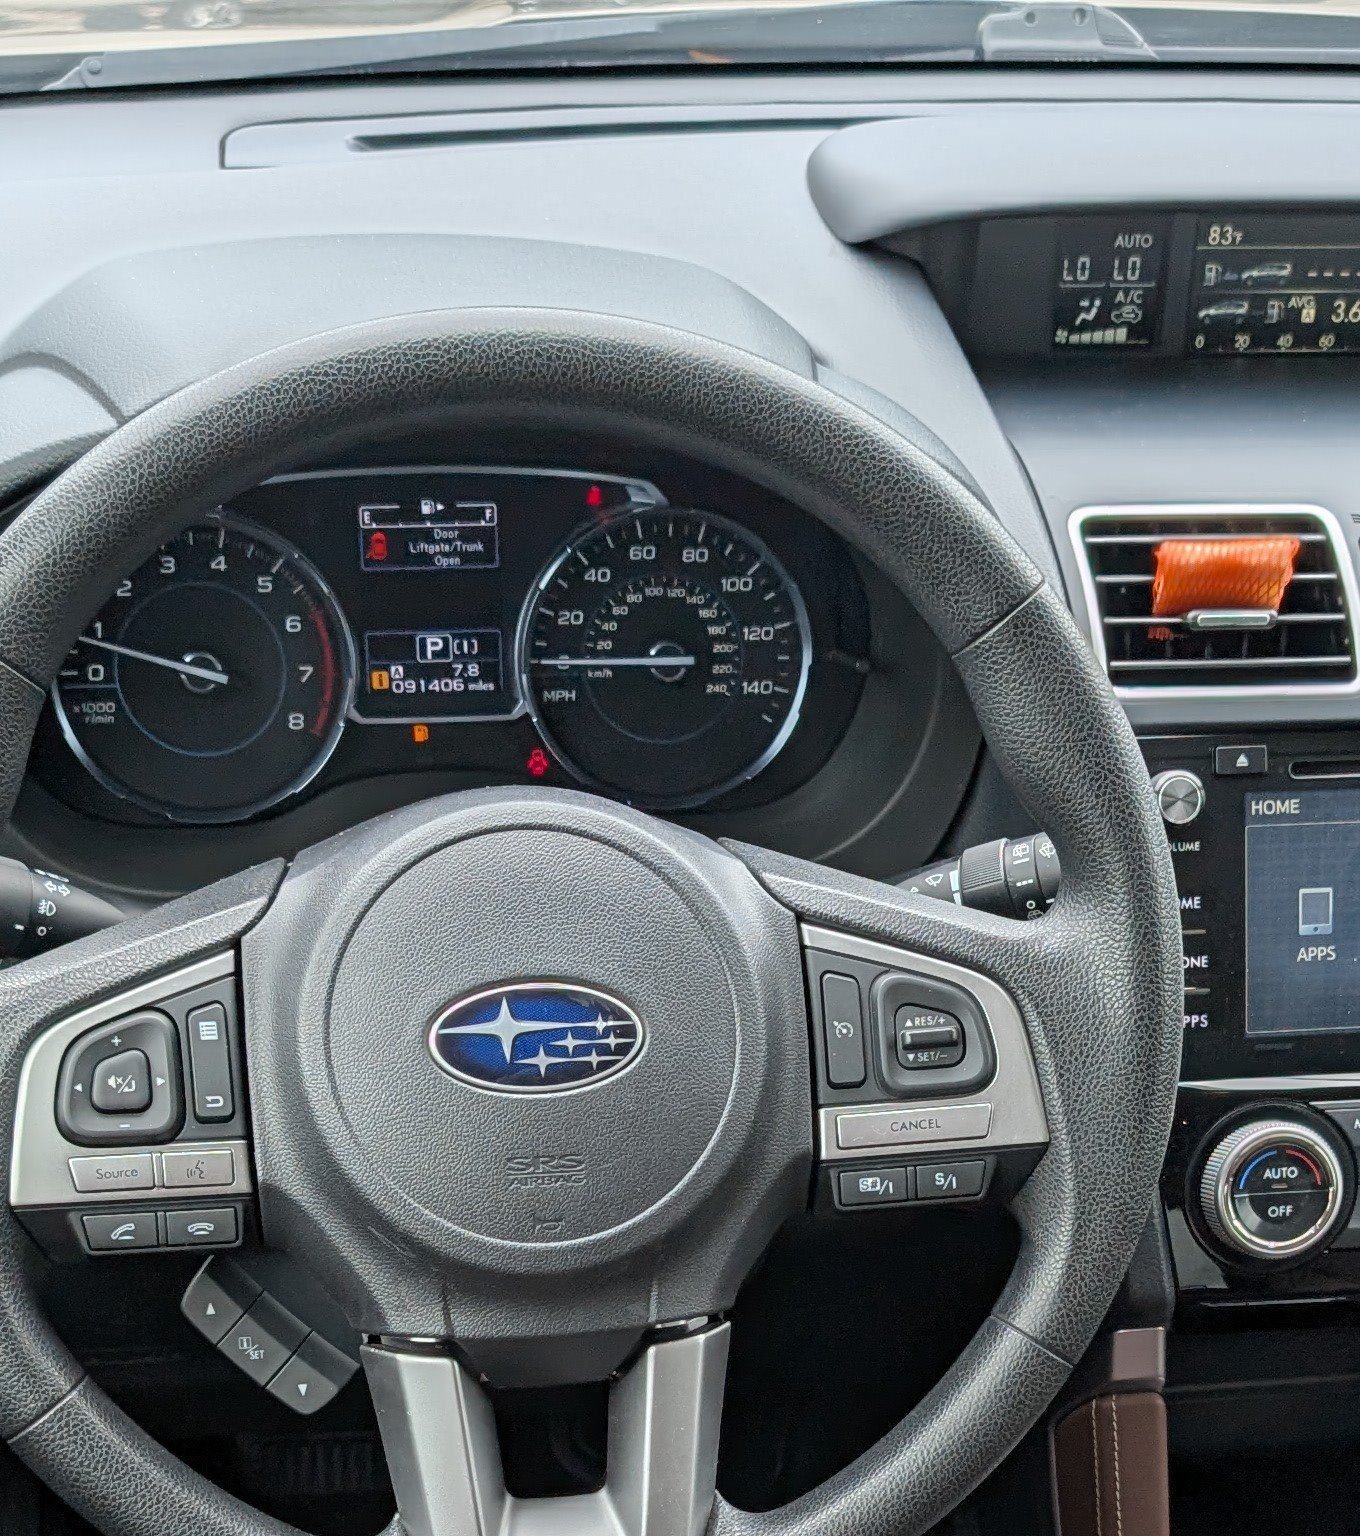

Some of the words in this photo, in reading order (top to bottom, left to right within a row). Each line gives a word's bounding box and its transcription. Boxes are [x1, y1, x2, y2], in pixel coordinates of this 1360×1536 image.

[1114, 233, 1153, 249] AUTO
[1063, 256, 1091, 281] LO
[1113, 256, 1141, 281] LO
[1114, 289, 1143, 304] A/C
[1288, 295, 1316, 310] AVG
[1195, 334, 1205, 349] 0
[1234, 333, 1251, 349] 20
[1276, 333, 1293, 348] 40
[1319, 333, 1335, 348] 60
[363, 511, 371, 524] E
[485, 508, 493, 521] F
[434, 529, 459, 540] Door
[409, 541, 484, 554] Liftgate/Trunk
[630, 547, 656, 560] 60
[434, 556, 461, 568] Open
[682, 549, 708, 563] 80
[160, 557, 176, 574] 3
[210, 555, 228, 572] 4
[584, 569, 611, 582] 40
[116, 580, 133, 597] 2
[257, 577, 273, 593] 5
[645, 587, 663, 597] 100
[721, 578, 752, 592] 100
[626, 594, 642, 603] 80
[667, 588, 685, 598] 120
[686, 595, 704, 605] 140
[612, 606, 628, 615] 60
[699, 609, 717, 618] 160
[285, 616, 302, 632] 6
[558, 611, 583, 625] 20
[94, 622, 102, 638] 1
[601, 622, 617, 631] 40
[708, 626, 726, 635] 180
[743, 627, 773, 641] 120
[426, 637, 443, 660] P
[597, 641, 612, 650] 20
[713, 644, 733, 653] 200
[88, 665, 104, 681] 0
[298, 666, 314, 683] 7
[452, 664, 480, 677] 7.8
[588, 669, 612, 678] km/h
[712, 665, 732, 674] 220
[392, 679, 465, 693] 091406
[468, 681, 494, 691] miles
[706, 684, 727, 693] 240
[742, 681, 772, 694] 140
[543, 690, 576, 702] MPH
[73, 702, 116, 713] x1000
[85, 714, 114, 724] r/min
[288, 713, 305, 730] 8
[1250, 799, 1300, 816] HOME
[1167, 841, 1201, 852] OLUME
[1177, 896, 1201, 909] ME
[1183, 955, 1209, 968] ONE
[1297, 947, 1336, 963] APPS
[1183, 1014, 1208, 1028] PPS
[890, 1119, 941, 1132] CANCEL
[506, 1153, 587, 1173] SRS
[96, 1165, 139, 1181] Source
[1263, 1166, 1298, 1181] AUTO
[508, 1177, 586, 1190] AIRBAG
[1268, 1203, 1293, 1218] OFF
